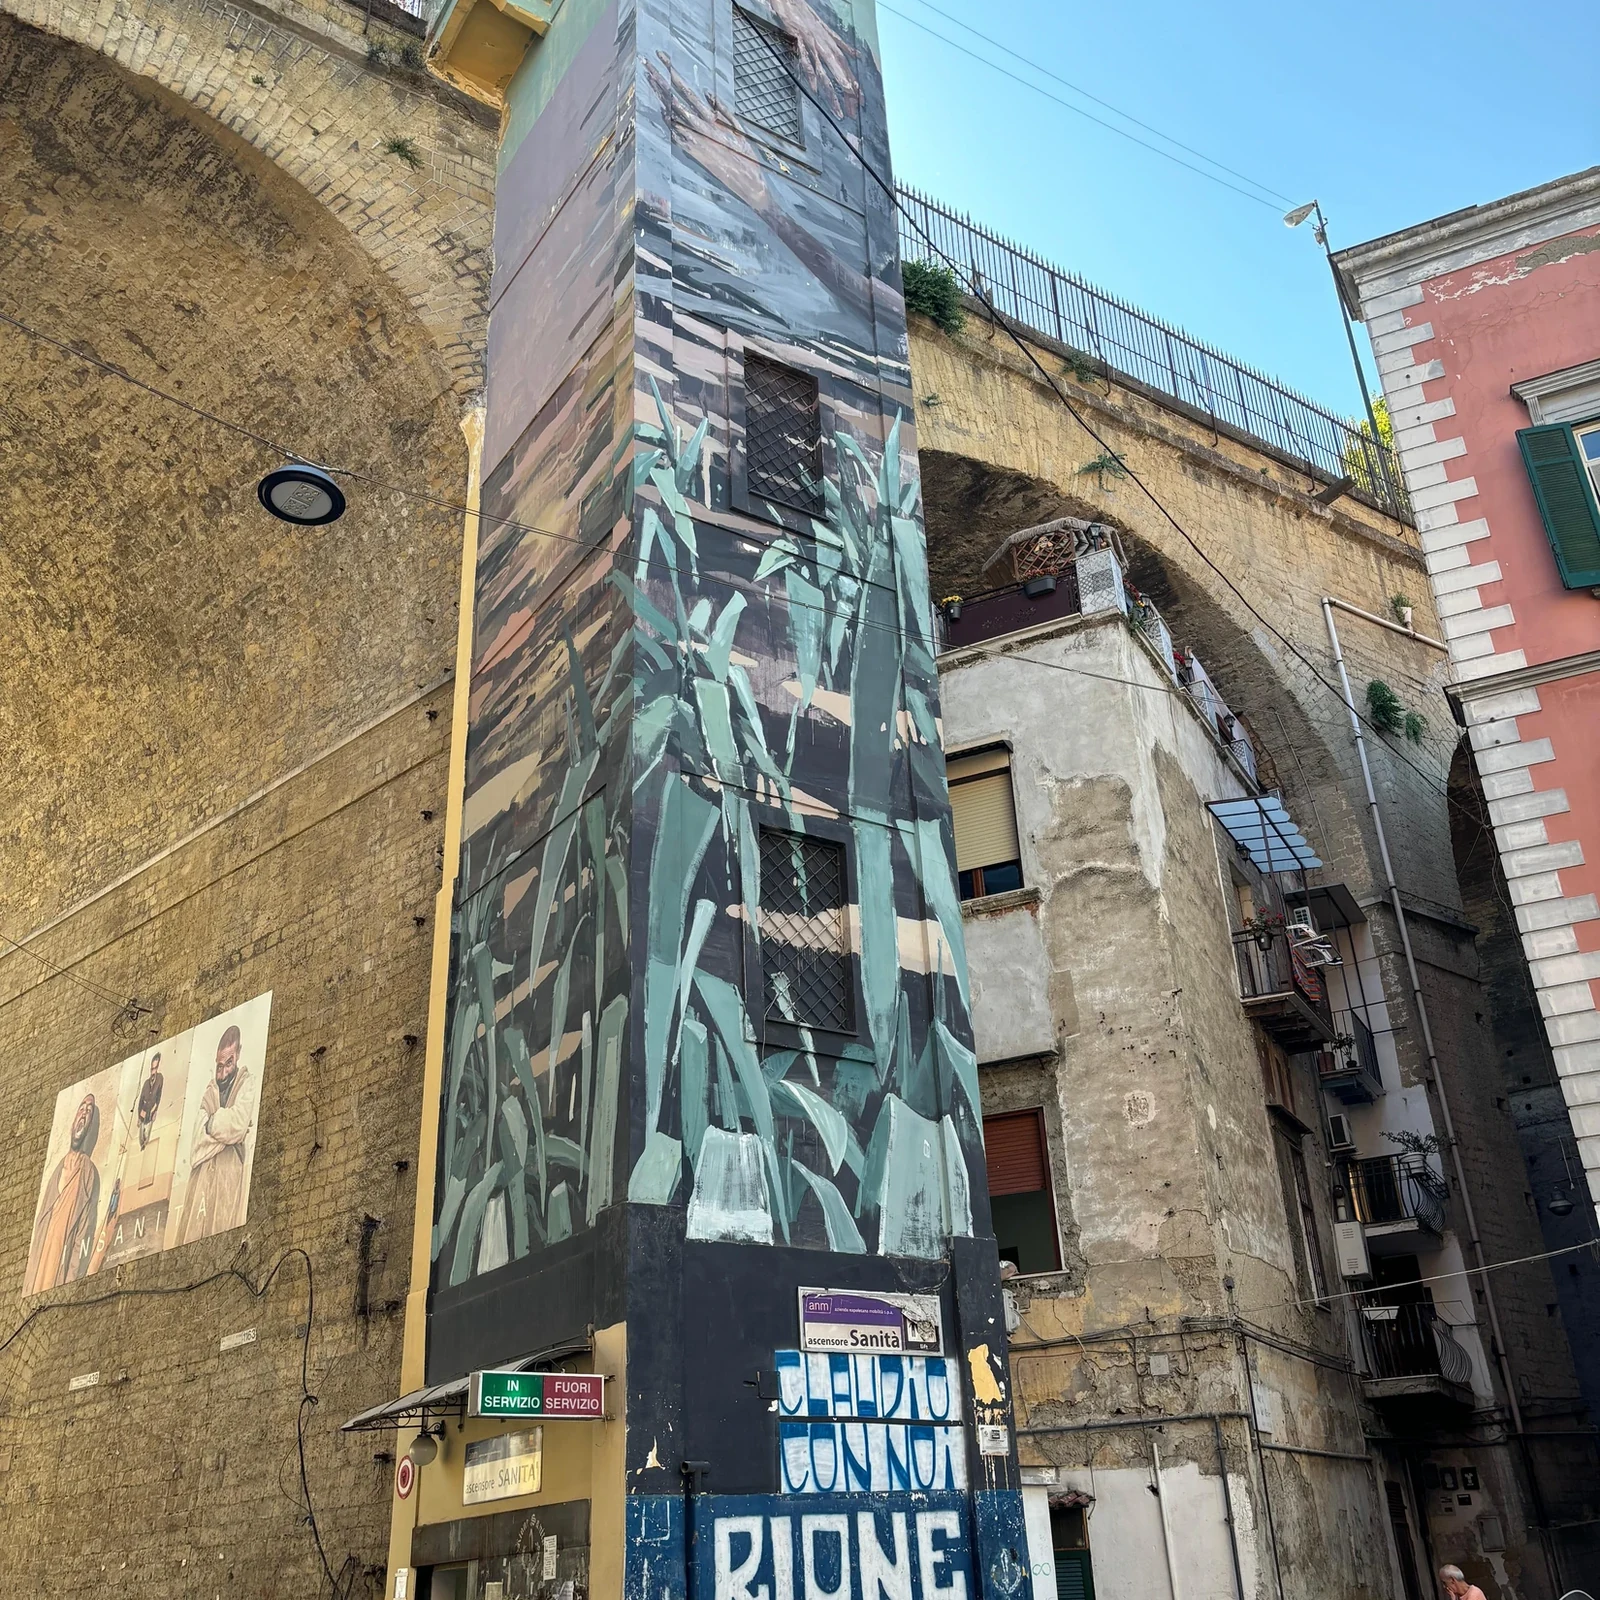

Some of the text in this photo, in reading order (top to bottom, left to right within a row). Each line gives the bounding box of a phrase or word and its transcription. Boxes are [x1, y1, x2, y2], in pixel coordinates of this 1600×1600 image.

[808, 1300, 829, 1311] anm
[808, 1329, 900, 1348] ascensore Sanità
[507, 1380, 519, 1391] IN
[555, 1382, 591, 1393] FUORI
[484, 1396, 540, 1408] SERVIZIO
[545, 1397, 599, 1410] SERVIZIO
[465, 1479, 495, 1494] ascensore
[714, 1510, 967, 1600] RIONE
